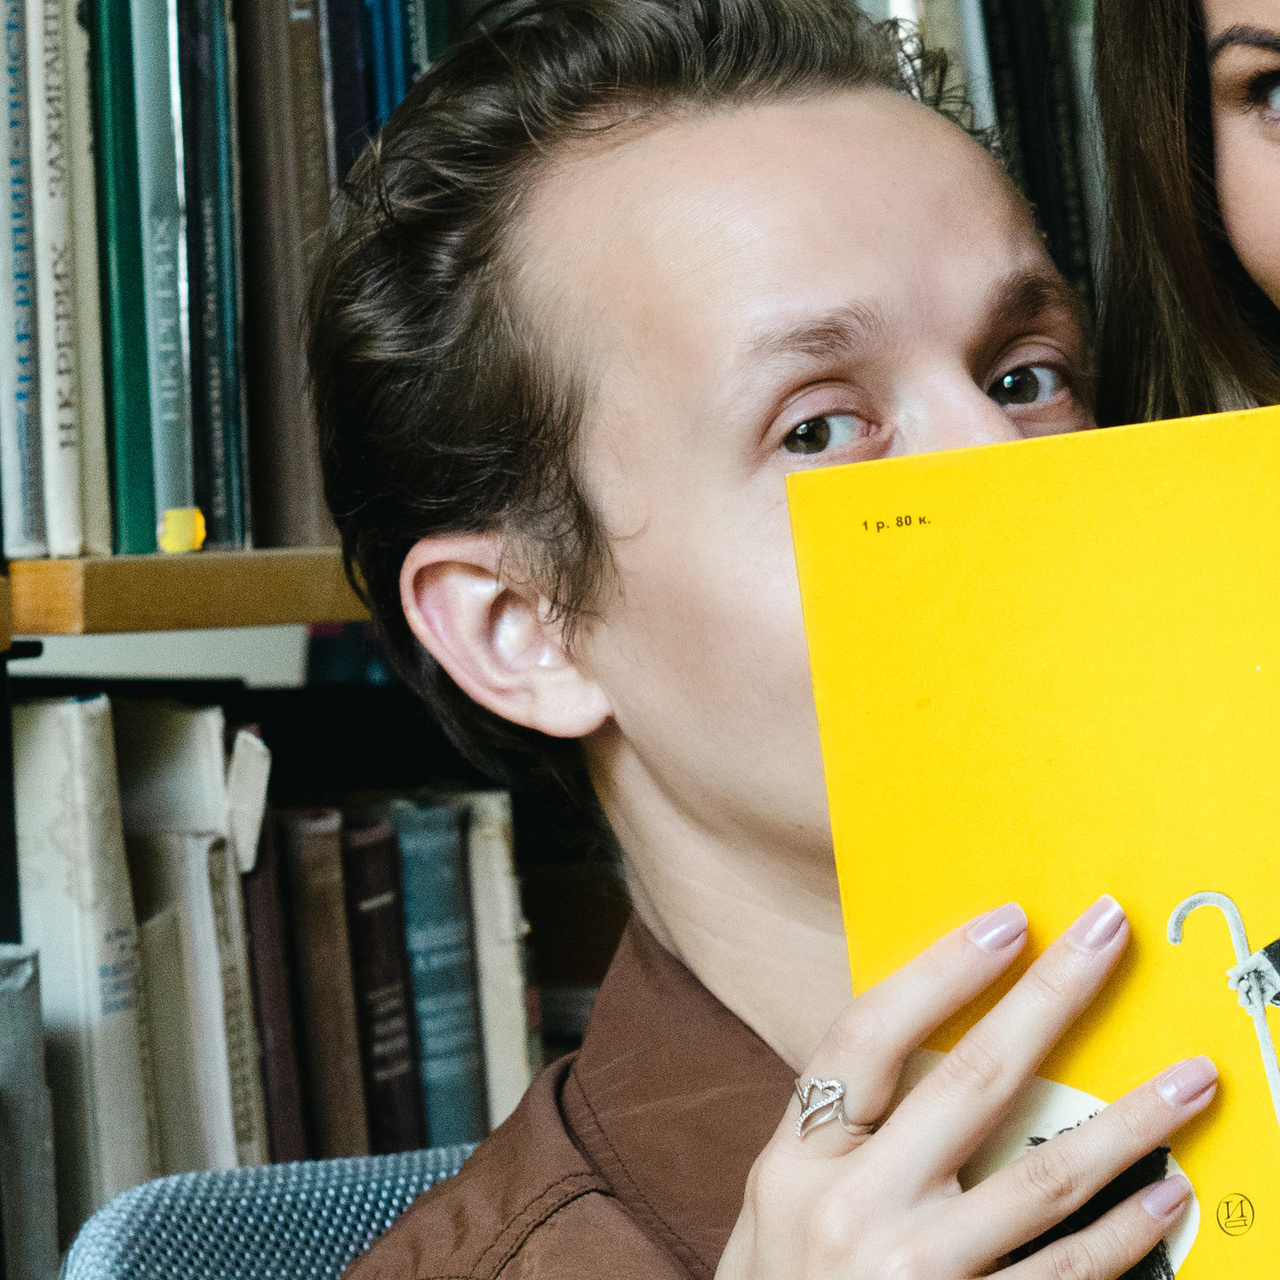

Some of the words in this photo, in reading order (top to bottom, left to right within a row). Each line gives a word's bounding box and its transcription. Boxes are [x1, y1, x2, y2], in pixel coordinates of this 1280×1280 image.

[863, 519, 868, 531] 1
[876, 521, 890, 533] р.
[896, 515, 912, 527] 80
[918, 516, 931, 525] к.
